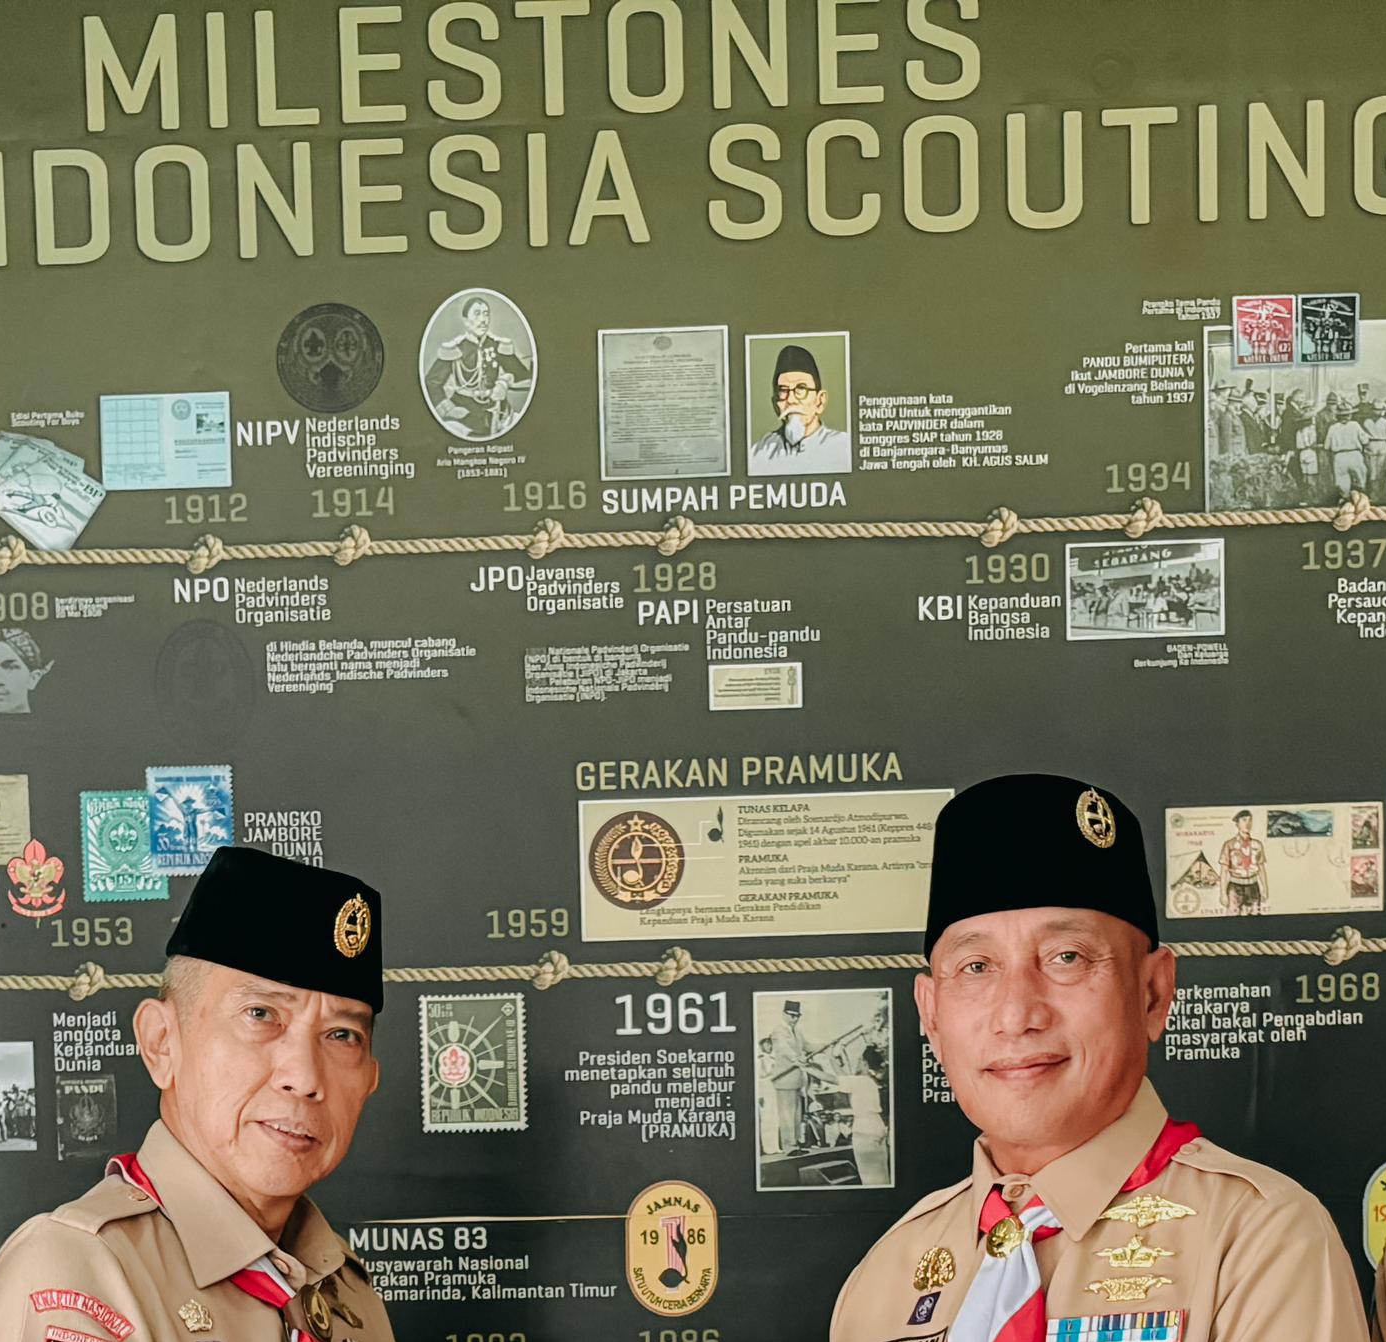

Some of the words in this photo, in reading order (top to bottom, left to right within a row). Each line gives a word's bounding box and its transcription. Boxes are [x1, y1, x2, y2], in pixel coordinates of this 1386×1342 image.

[82, 0, 981, 132] MILESTONES
[1125, 342, 1172, 354] Pertama
[1174, 340, 1195, 352] kali
[1082, 355, 1121, 368] PANDU
[1094, 367, 1148, 381] JAMBORE
[1150, 366, 1185, 378] DUNIA
[929, 393, 954, 404] kata
[1166, 391, 1195, 404] 1937
[858, 407, 896, 419] PANDU
[899, 406, 932, 418] Untuk
[236, 419, 300, 447] NIPV
[305, 414, 401, 433] Nederlands
[885, 418, 948, 431] PADVINDER
[305, 431, 376, 447] Indische
[939, 431, 973, 442] tahun
[305, 446, 399, 464] Padvinders
[982, 454, 1013, 467] AGUS
[1015, 453, 1049, 466] SALIM
[306, 461, 415, 480] Vereeninging
[1105, 461, 1191, 495] 1934
[311, 486, 395, 518] 1914
[502, 480, 588, 513] 1916
[602, 485, 720, 515] SUMPAH
[729, 481, 848, 511] PEMUDA
[165, 493, 248, 524] 1912
[525, 565, 596, 582] Javanse
[631, 562, 718, 595] 1928
[963, 552, 1051, 586] 1930
[233, 575, 329, 593] Nederlands
[469, 566, 525, 593] JPO
[525, 579, 621, 597] Padvinders
[1337, 576, 1386, 593] Badan
[172, 576, 230, 604] NPO
[234, 591, 327, 609] Padvinders
[526, 593, 625, 616] Organisatie
[705, 597, 792, 615] Persatuan
[917, 595, 963, 623] KBI
[967, 592, 1062, 614] Kepanduan
[235, 606, 332, 627] Organisatie
[636, 599, 699, 627] PAPI
[705, 613, 751, 630] Antar
[967, 608, 1031, 630] Bangsa
[705, 625, 821, 647] Pandu-pandu
[967, 624, 1051, 642] Indonesia
[370, 637, 411, 650] muncul
[414, 636, 456, 650] cabang
[705, 643, 788, 660] Indonesia
[375, 657, 420, 671] menjadi
[386, 667, 449, 680] Padvinders
[574, 758, 729, 792] GERAKAN
[741, 752, 904, 786] PRAMUKA
[738, 805, 771, 814] TUNAS
[772, 804, 811, 813] KELAPA
[244, 811, 322, 828] PRANGKO
[243, 826, 323, 843] JAMBORE
[271, 841, 324, 858] DUNIA
[50, 916, 134, 948] 1953
[485, 908, 570, 939] 1959
[1295, 971, 1381, 1004] 1968
[52, 1011, 117, 1030] Menjadi
[613, 991, 737, 1036] 1961
[1165, 1014, 1208, 1031] Cikal
[1211, 1012, 1258, 1029] bakal
[1262, 1009, 1364, 1030] Pengabdian
[53, 1028, 122, 1045] anggota
[1165, 1028, 1265, 1047] masyarakat
[1270, 1027, 1307, 1044] oleh
[579, 1050, 652, 1067] Presiden
[657, 1048, 736, 1065] Soekarno
[1165, 1044, 1241, 1061] Pramuka
[54, 1057, 102, 1073] Dunia
[564, 1065, 668, 1083] menetapkan
[671, 1063, 736, 1080] seluruh
[610, 1080, 663, 1099] pandu
[667, 1077, 736, 1095] melebur
[654, 1093, 721, 1112] menjadi
[579, 1110, 623, 1129] Praja
[628, 1109, 673, 1125] Muda
[677, 1107, 737, 1124] Karana
[646, 1196, 701, 1216] JAMNAS
[348, 1227, 445, 1252] MUNAS
[454, 1226, 488, 1251] 83
[458, 1254, 530, 1271] Nasional
[424, 1270, 496, 1287] Pramuka
[471, 1283, 567, 1301] Kalimantan
[570, 1281, 618, 1299] Timur
[80, 1295, 130, 1340] NASIONAL
